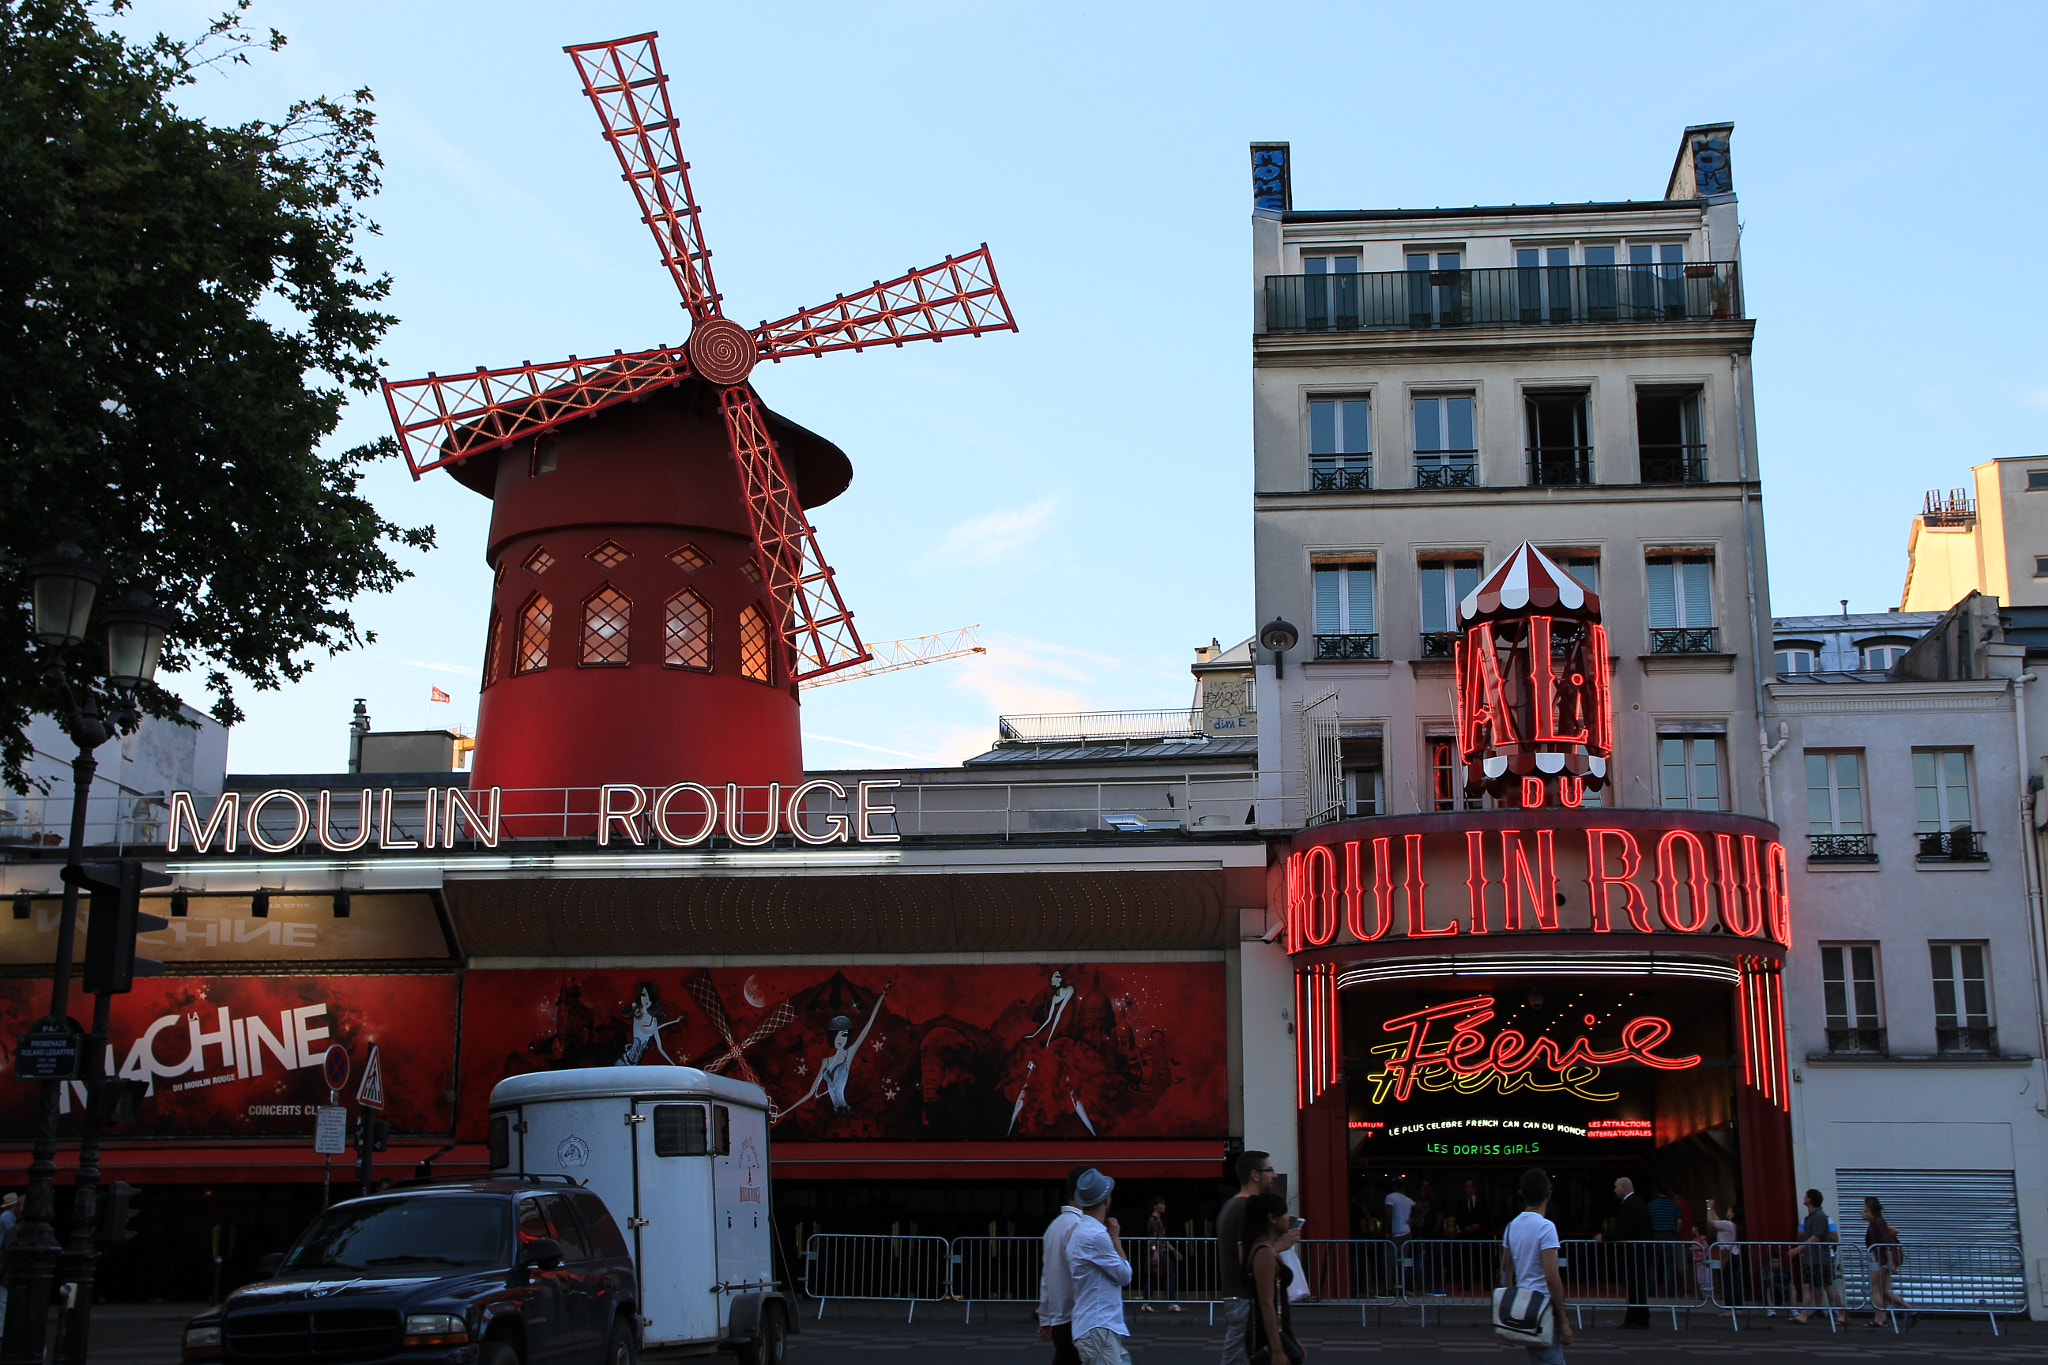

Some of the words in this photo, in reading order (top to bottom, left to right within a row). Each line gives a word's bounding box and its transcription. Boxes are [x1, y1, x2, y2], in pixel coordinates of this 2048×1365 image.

[1522, 776, 1584, 808] DU
[166, 785, 502, 854] MOULIN
[596, 778, 902, 847] ROUGE
[1586, 827, 1792, 952] ROUG
[187, 1012, 199, 1022] LA
[1383, 994, 1702, 1101] Féerie
[173, 1081, 183, 1093] DU
[184, 1077, 212, 1091] MOULIN
[212, 1073, 236, 1086] ROUGE
[248, 1104, 302, 1116] CONCERTS
[304, 1104, 318, 1116] CL
[1388, 1127, 1400, 1137] LE
[1402, 1123, 1425, 1135] PLUS
[1426, 1120, 1463, 1131] CELEBRE
[1465, 1119, 1499, 1128] FRENCH
[1502, 1120, 1520, 1128] CAN
[1523, 1121, 1540, 1130] CAN
[1541, 1122, 1554, 1131] DU
[1557, 1124, 1587, 1137] MONDE
[1602, 1120, 1652, 1128] ATTRACTIONS
[1587, 1129, 1653, 1138] INTERNATIONALES
[1427, 1143, 1448, 1154] LES
[1453, 1144, 1500, 1156] DORISS
[1503, 1142, 1540, 1156] GIRLS
